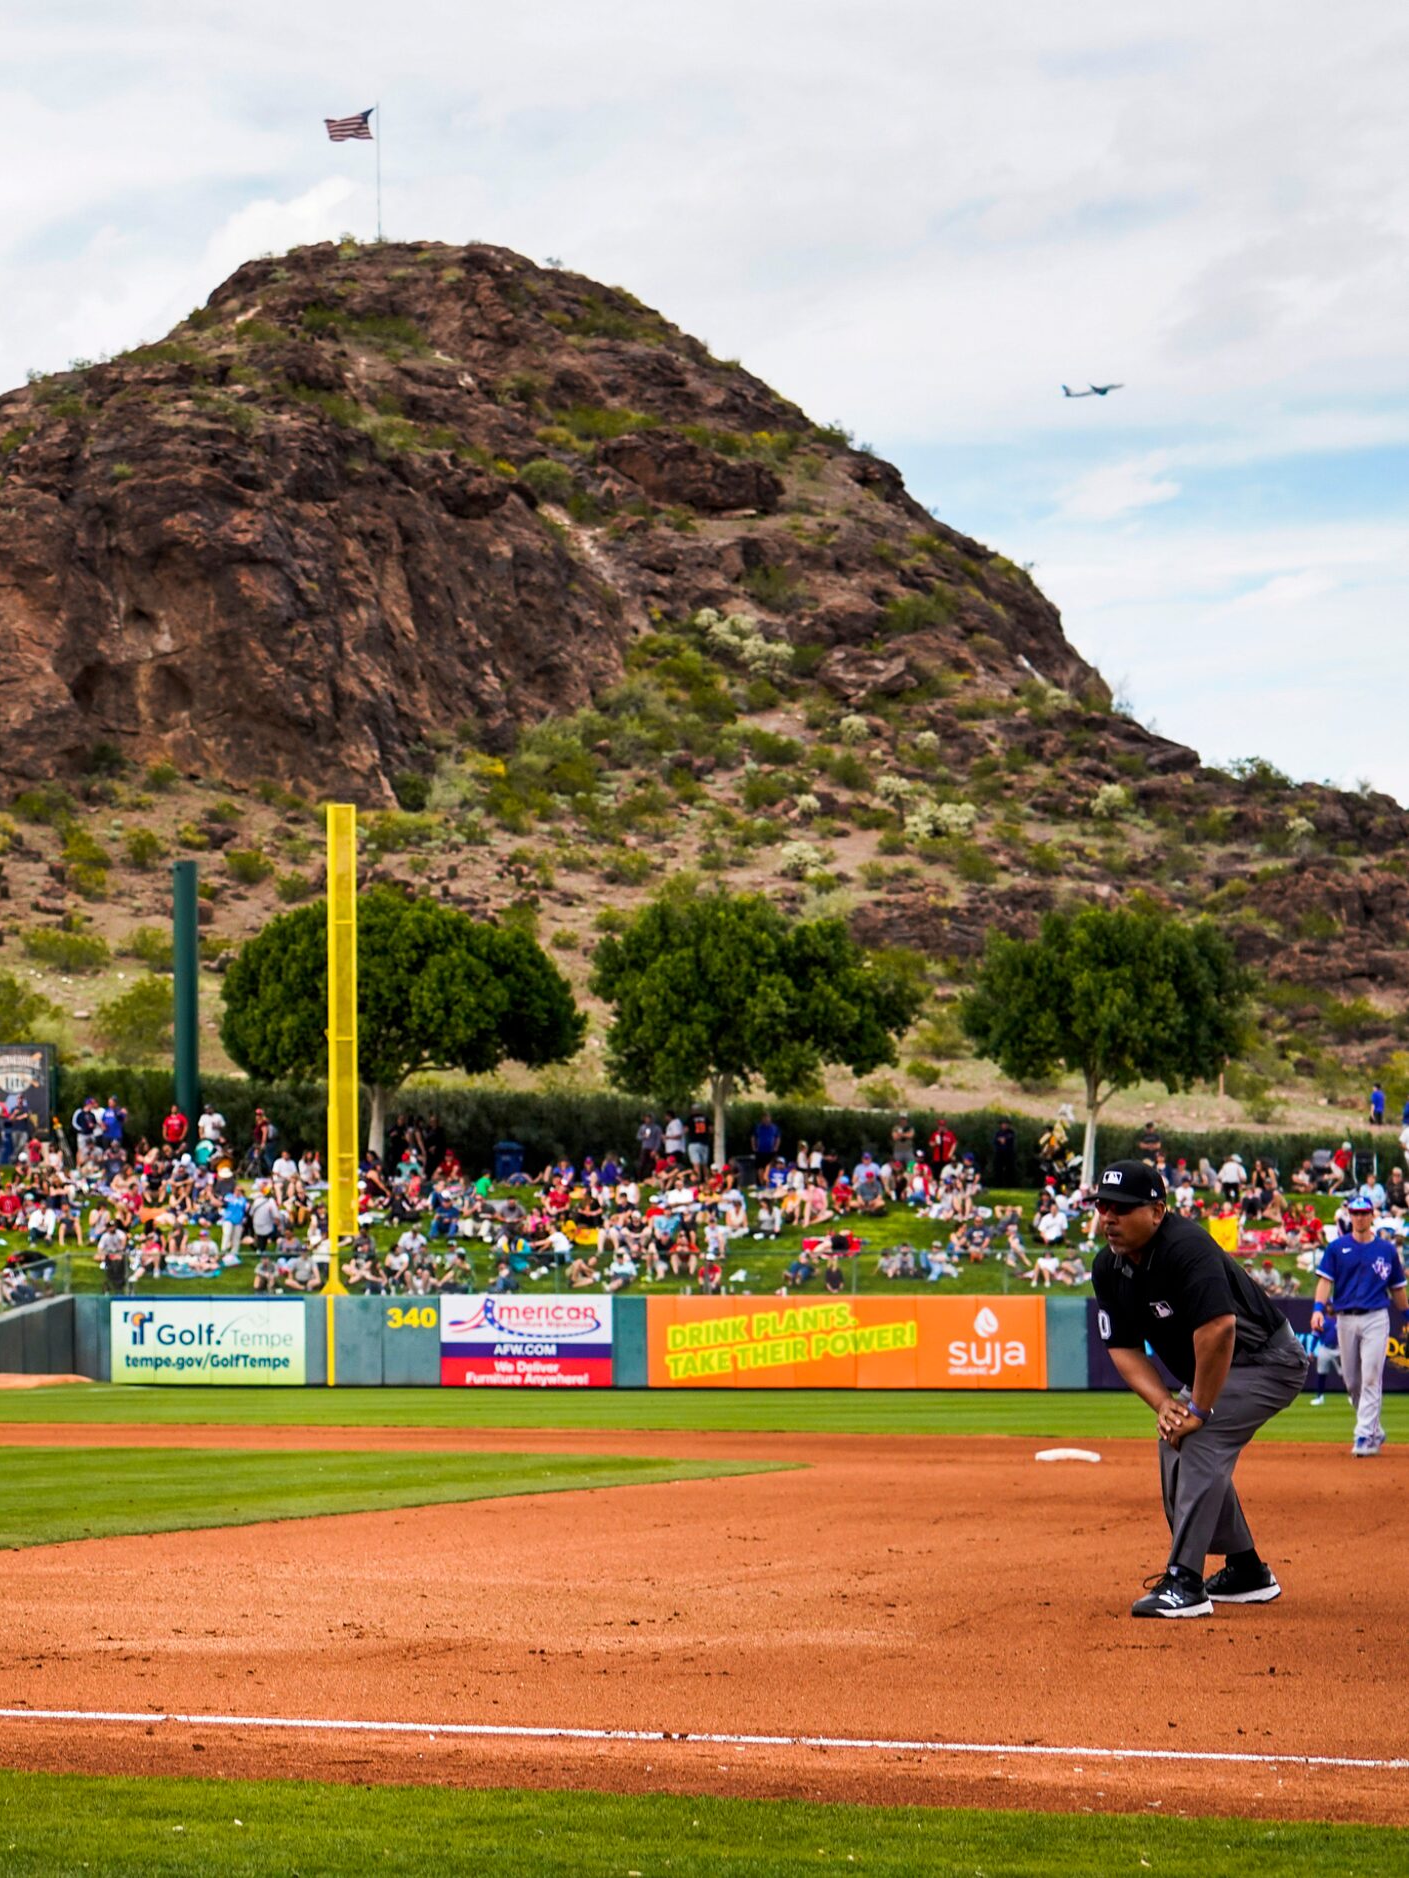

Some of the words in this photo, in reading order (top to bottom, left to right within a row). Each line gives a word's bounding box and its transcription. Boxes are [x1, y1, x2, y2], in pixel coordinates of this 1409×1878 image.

[387, 1307, 437, 1329] 340
[667, 1316, 749, 1351] DRINK
[752, 1303, 859, 1339] PLANTS.
[231, 1329, 293, 1349] Tempe
[493, 1344, 557, 1356] AFW.COM
[666, 1349, 733, 1380] TAKE
[734, 1338, 809, 1370] THEIR
[812, 1321, 917, 1360] POWER!
[948, 1340, 1026, 1376] suja
[125, 1352, 290, 1371] tempe.gov/GolfTempe
[493, 1361, 515, 1372] We
[516, 1361, 560, 1372] Deliver
[465, 1372, 522, 1385] Furniture
[523, 1372, 589, 1387] Anywhere!
